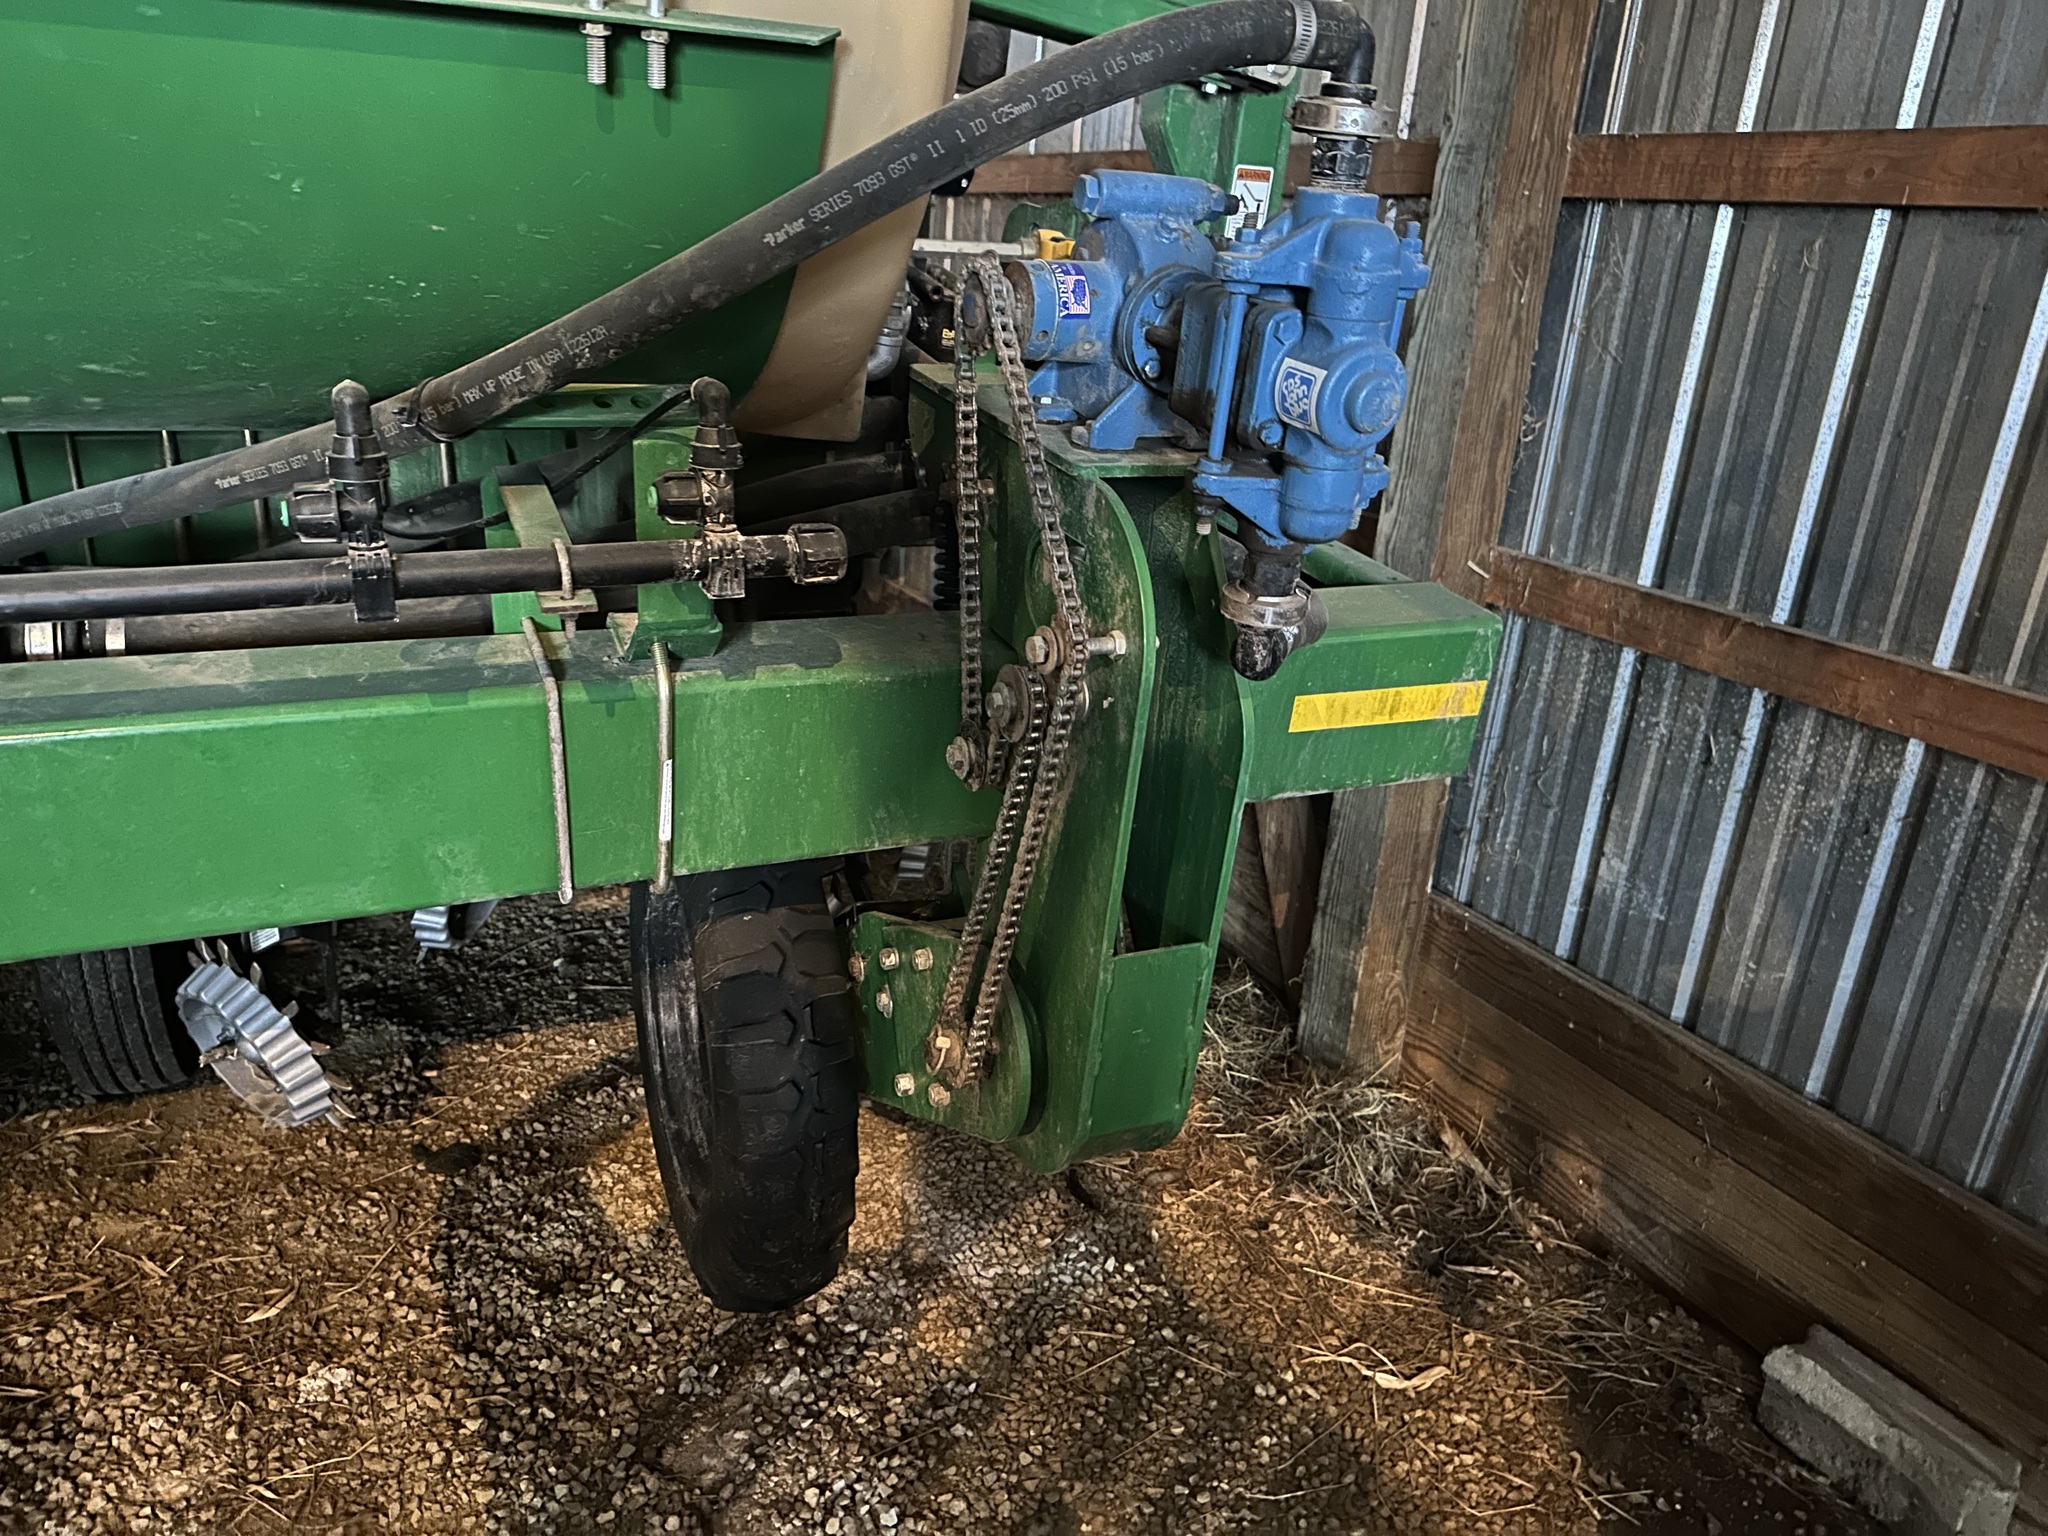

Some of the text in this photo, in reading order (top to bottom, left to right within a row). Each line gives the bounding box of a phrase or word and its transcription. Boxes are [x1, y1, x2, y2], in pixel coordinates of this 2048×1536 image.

[762, 217, 806, 247] Parker
[808, 190, 853, 222] SERIES
[852, 172, 886, 197] 7093
[954, 129, 966, 144] 1
[969, 118, 988, 137] ID
[993, 94, 1037, 126] (25mm)
[1041, 81, 1067, 101] 200
[1071, 70, 1098, 90] PSI
[1103, 57, 1129, 78] (15
[1131, 43, 1164, 66] bar)
[1051, 264, 1069, 318] AMERICA
[241, 466, 269, 483] SERIES
[462, 383, 484, 405] MAX
[484, 378, 497, 397] WP
[498, 365, 526, 388] MADE
[528, 357, 542, 375] IN
[543, 347, 564, 367] USA
